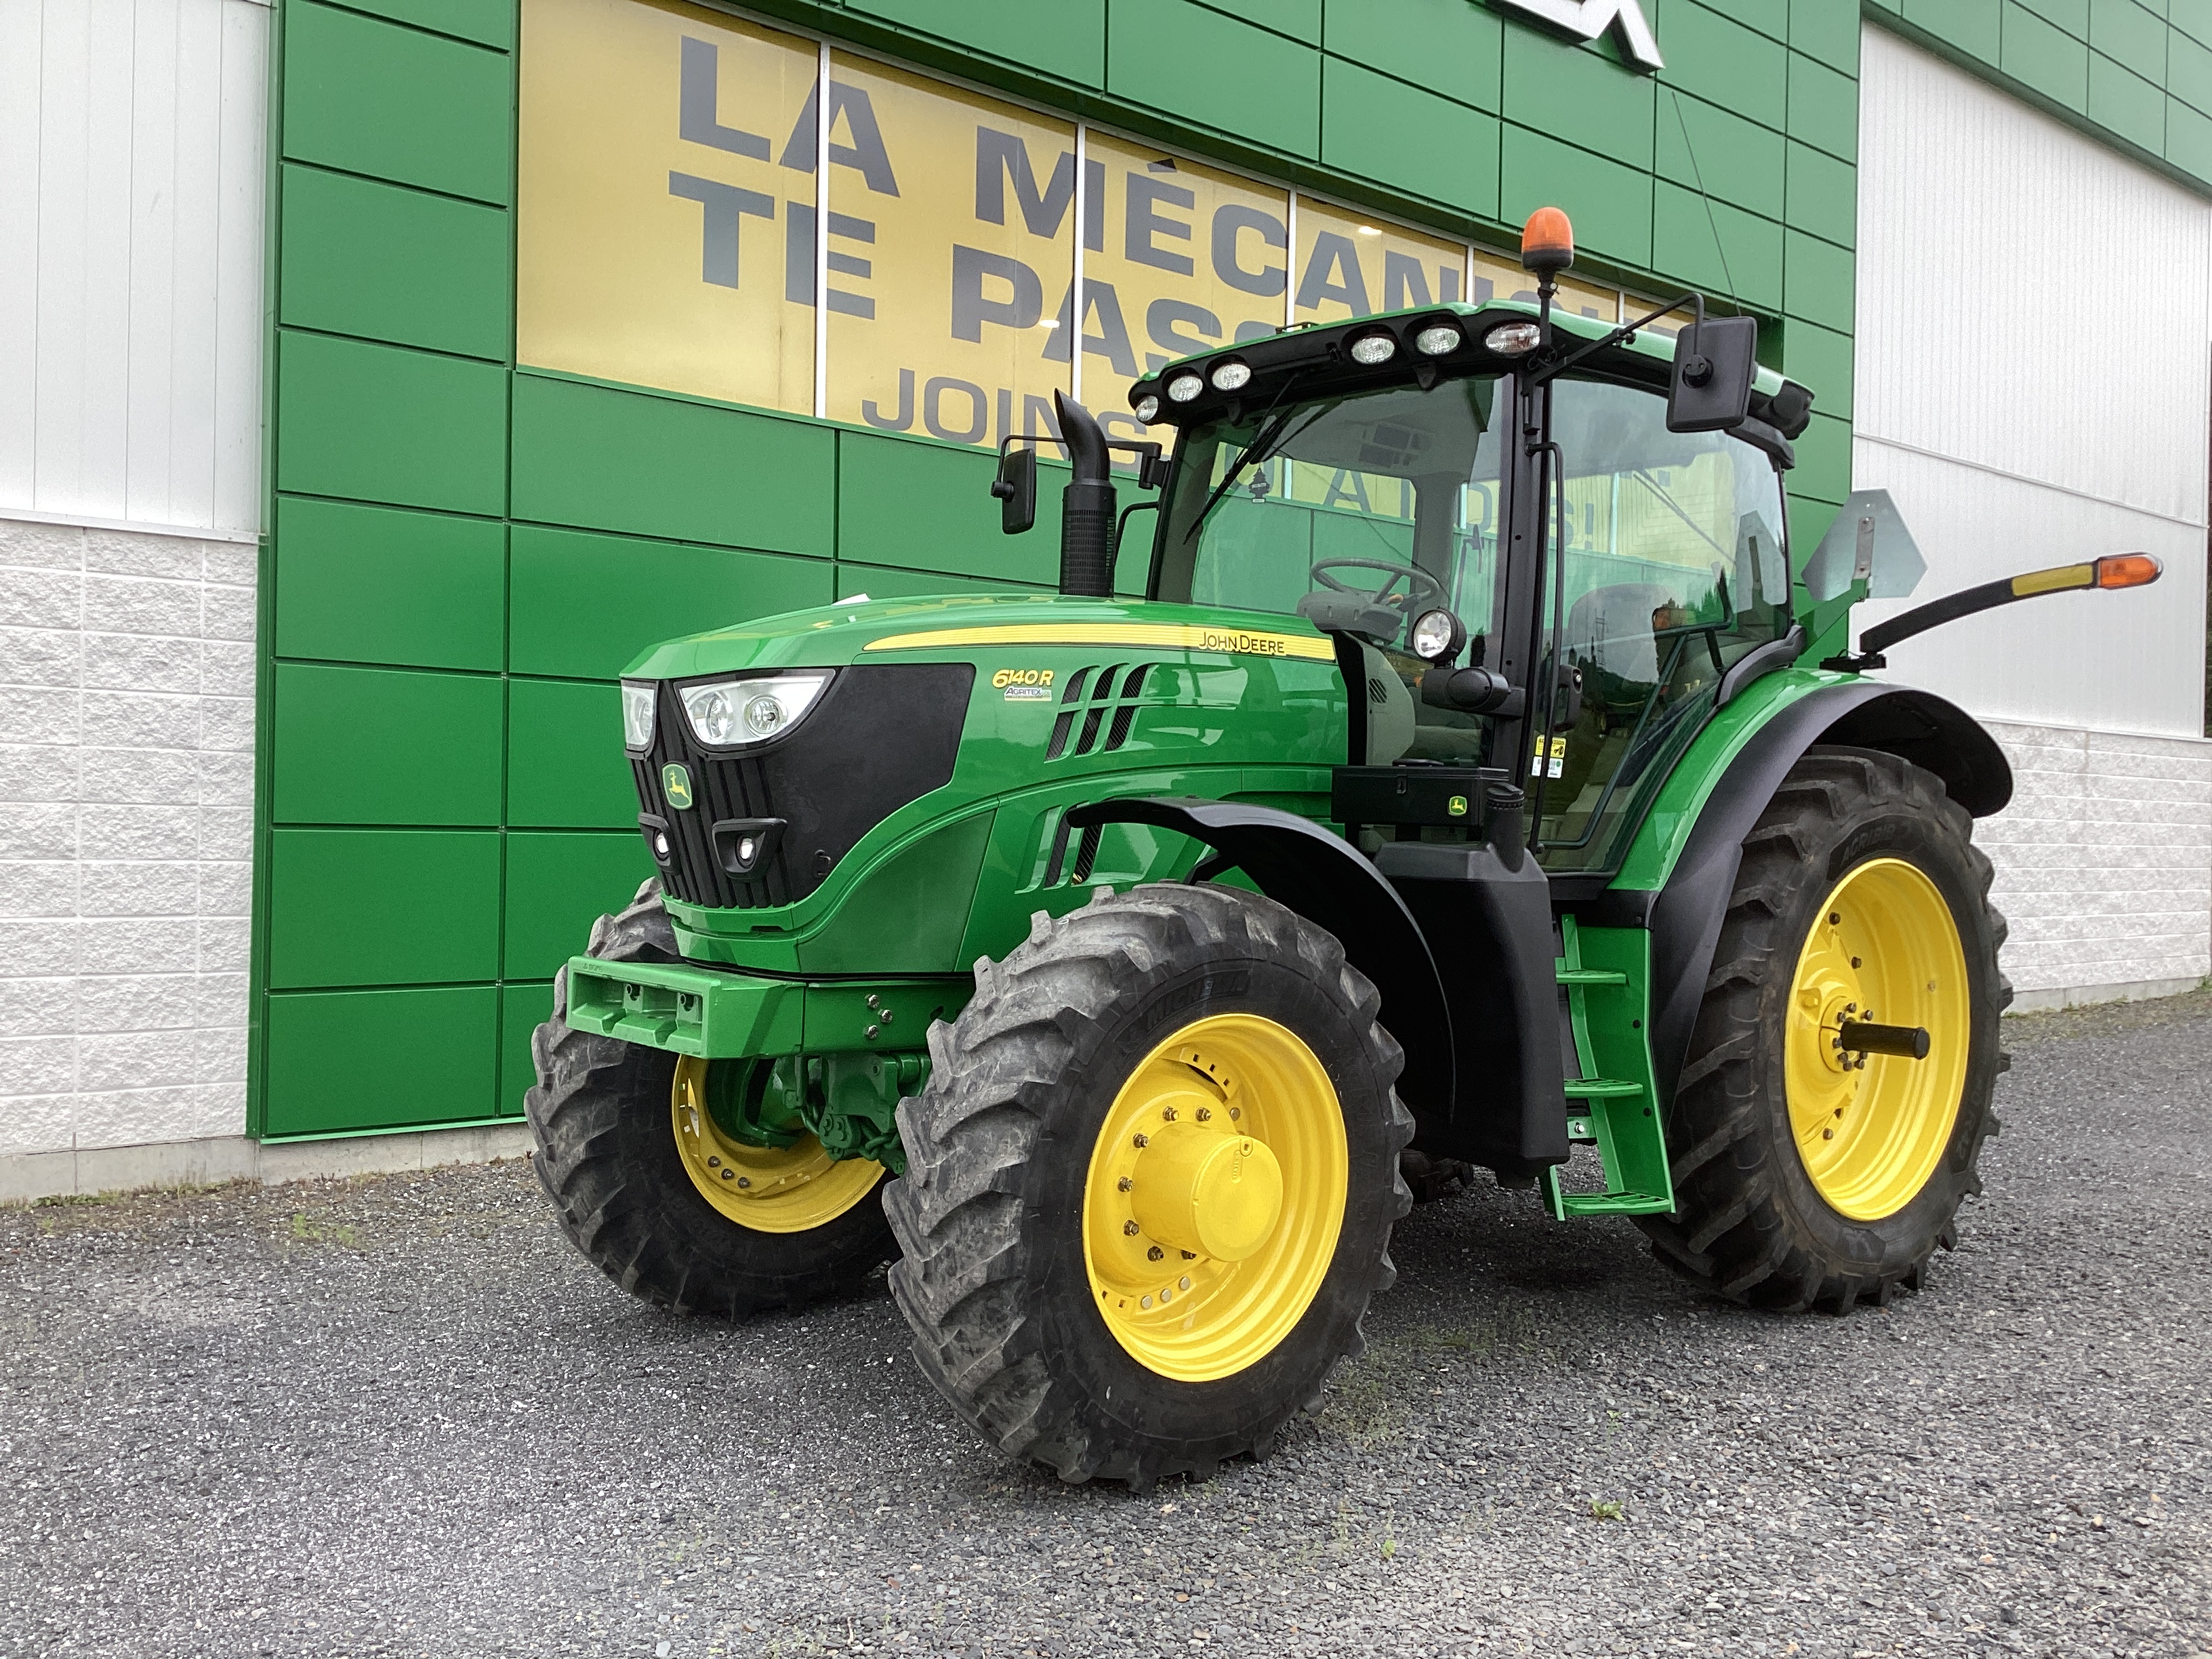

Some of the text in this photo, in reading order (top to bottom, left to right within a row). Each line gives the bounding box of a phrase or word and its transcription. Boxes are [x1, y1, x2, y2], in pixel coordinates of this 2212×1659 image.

[680, 35, 901, 199] LA
[668, 170, 1279, 380] TE PAS
[1199, 631, 1286, 653] JOHN DEERE
[1006, 687, 1042, 695] AGRITEX
